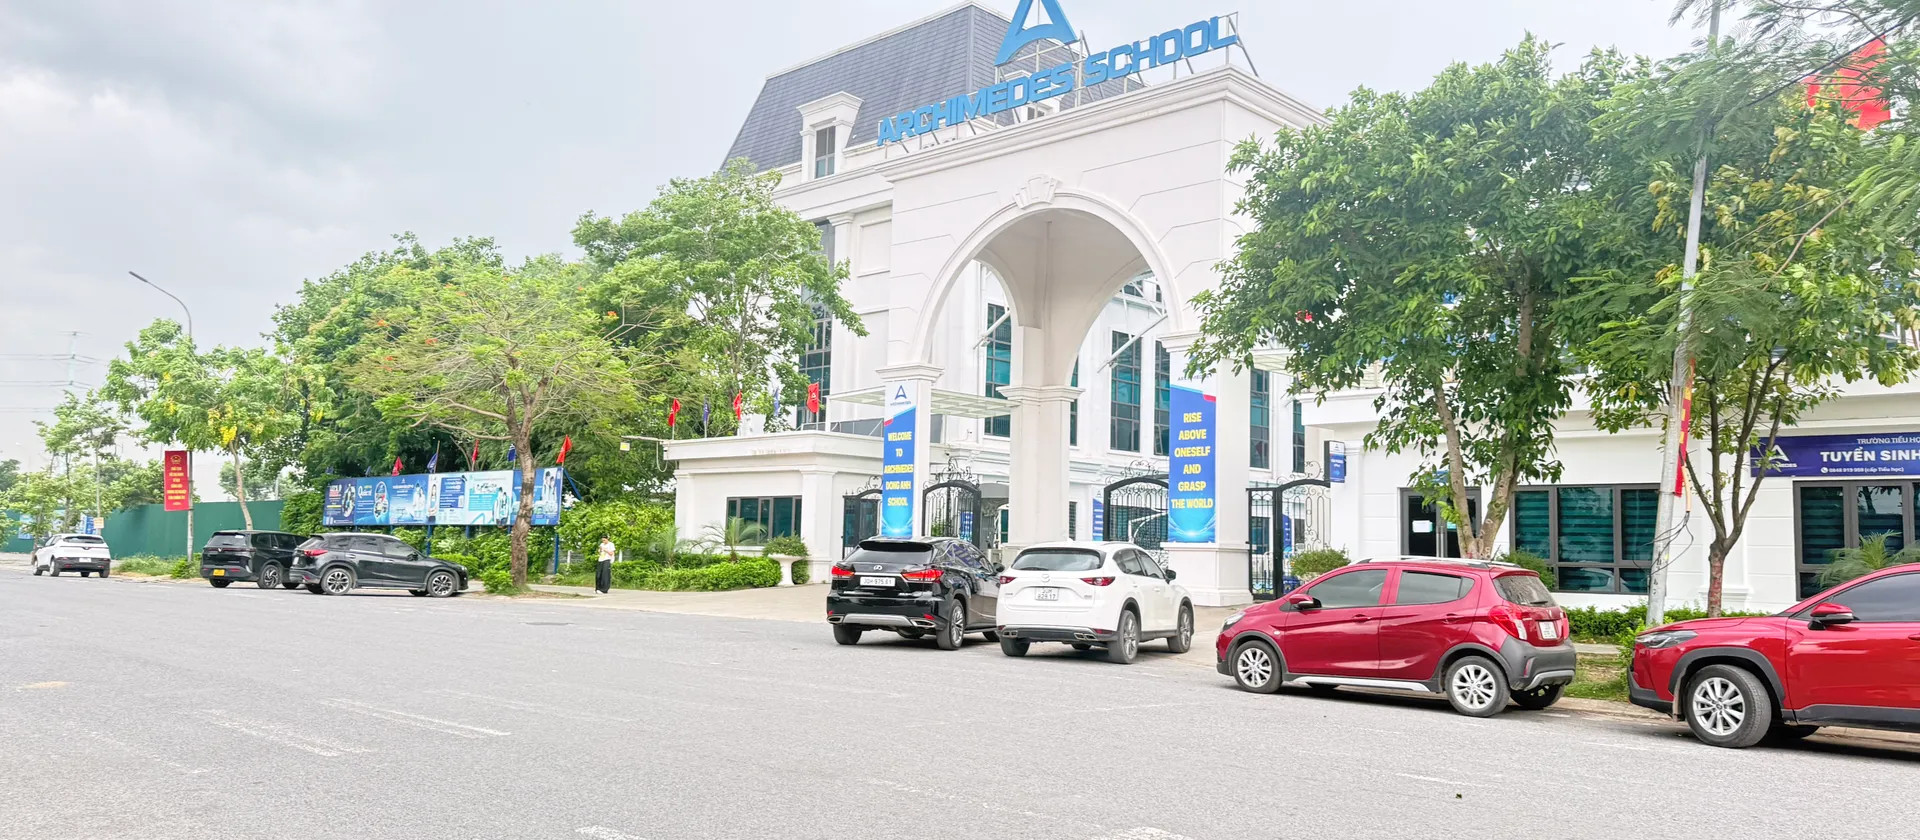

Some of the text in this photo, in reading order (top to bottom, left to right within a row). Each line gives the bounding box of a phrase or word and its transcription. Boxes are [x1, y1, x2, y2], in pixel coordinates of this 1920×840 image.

[877, 16, 1239, 146] ARCHIMEDES SCHOOL
[1183, 412, 1203, 423] RISE
[888, 432, 912, 441] WELCOME
[1178, 429, 1207, 441] ABOVE
[895, 448, 903, 457] TO
[1174, 446, 1211, 458] ONESELF
[1820, 446, 1920, 462] TUYỂN SINH
[1183, 464, 1201, 475] AND
[1178, 481, 1206, 492] GRASP
[887, 497, 908, 506] SCHOOL
[1171, 498, 1213, 509] THE WORLD
